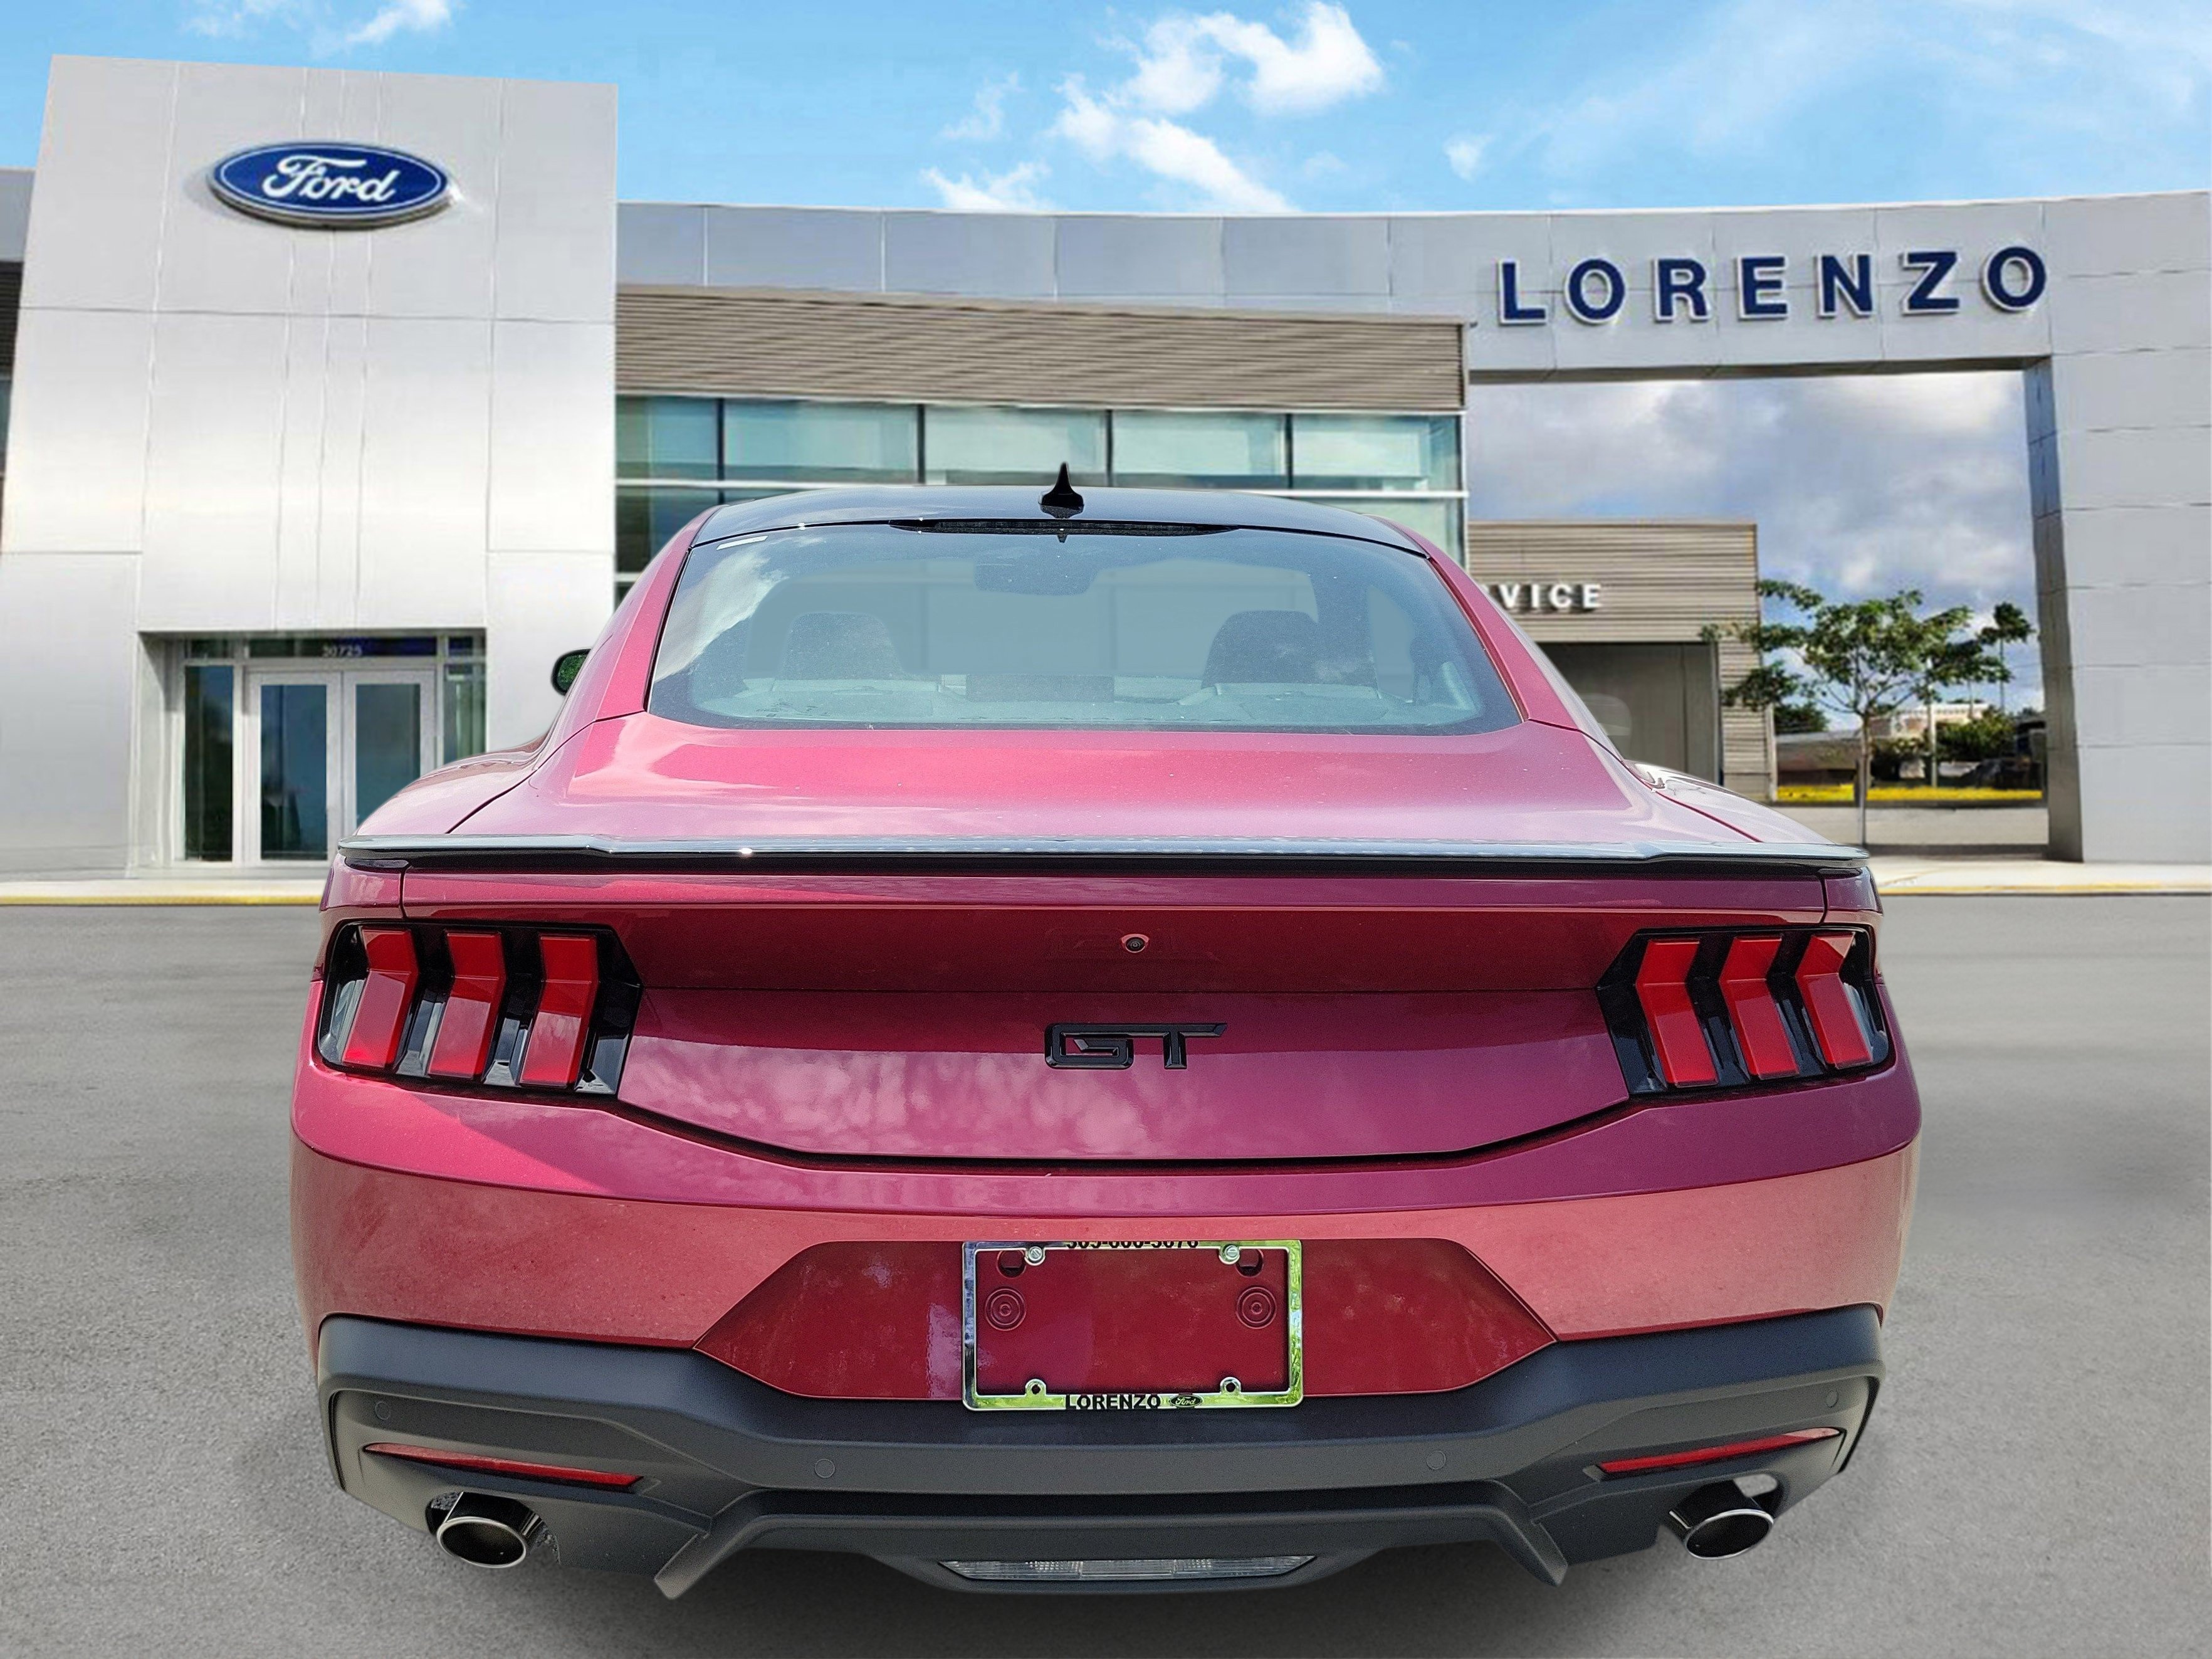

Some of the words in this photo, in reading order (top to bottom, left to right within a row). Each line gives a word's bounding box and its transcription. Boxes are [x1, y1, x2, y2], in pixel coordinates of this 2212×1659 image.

[261, 154, 401, 203] Ford
[1497, 246, 2047, 325] LORENZO
[1480, 583, 1603, 609] VICE
[1044, 1023, 1227, 1070] GT
[1066, 1393, 1161, 1410] LORENZO
